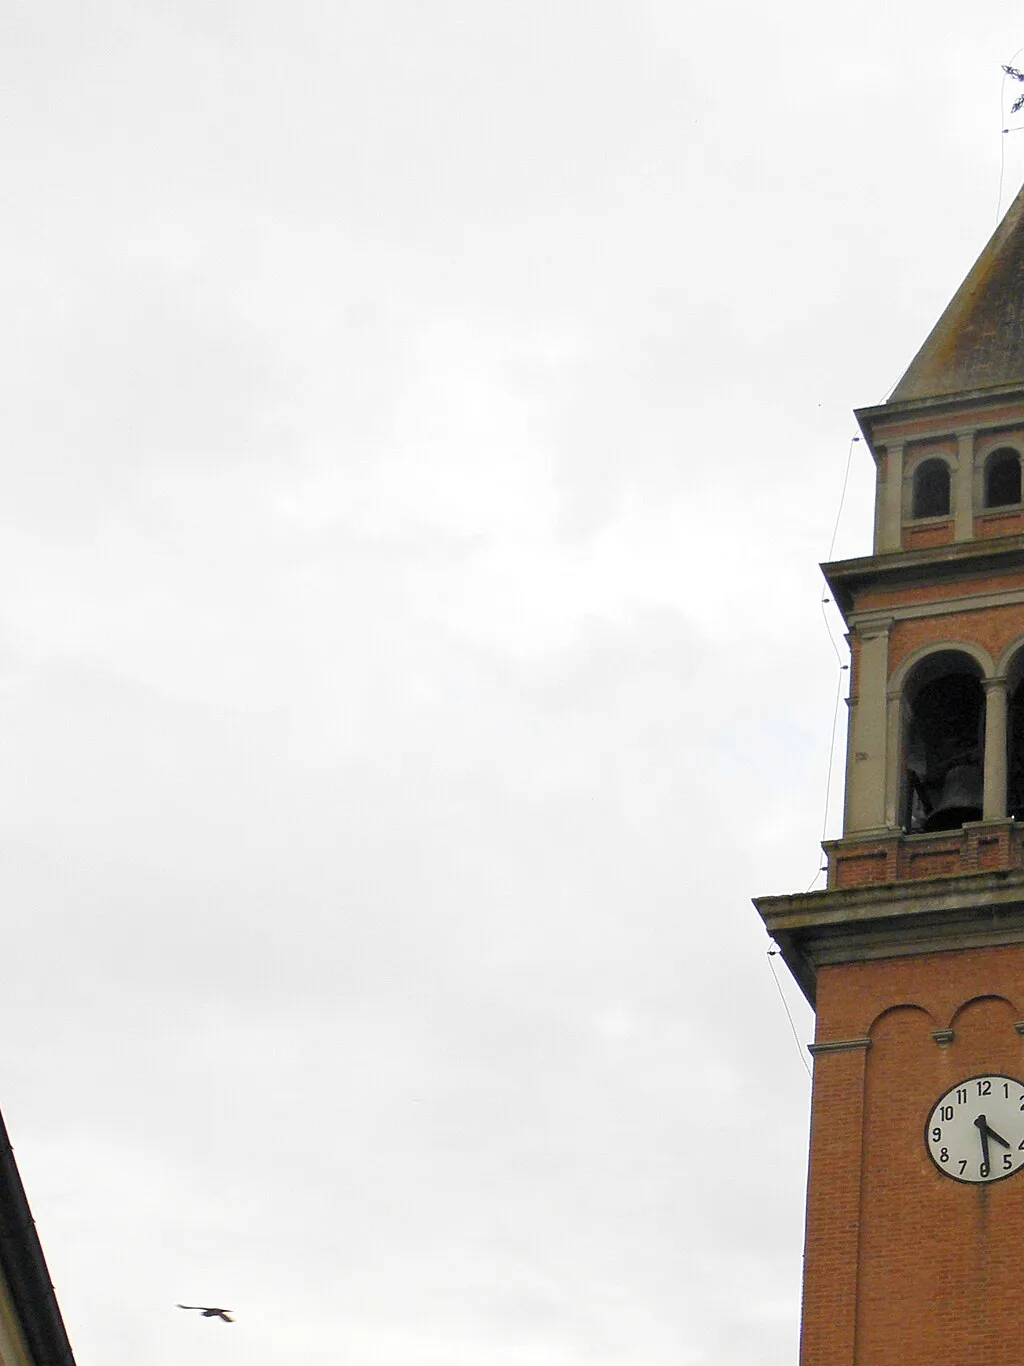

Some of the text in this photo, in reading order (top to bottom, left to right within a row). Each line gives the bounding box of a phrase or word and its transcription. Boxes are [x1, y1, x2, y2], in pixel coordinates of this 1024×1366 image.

[956, 1088, 967, 1104] 11
[976, 1080, 992, 1096] 12
[1002, 1083, 1009, 1099] 1
[940, 1105, 954, 1121] 10
[932, 1127, 941, 1142] 9
[940, 1147, 949, 1163] 8
[1003, 1154, 1012, 1170] 5
[958, 1160, 967, 1175] 7
